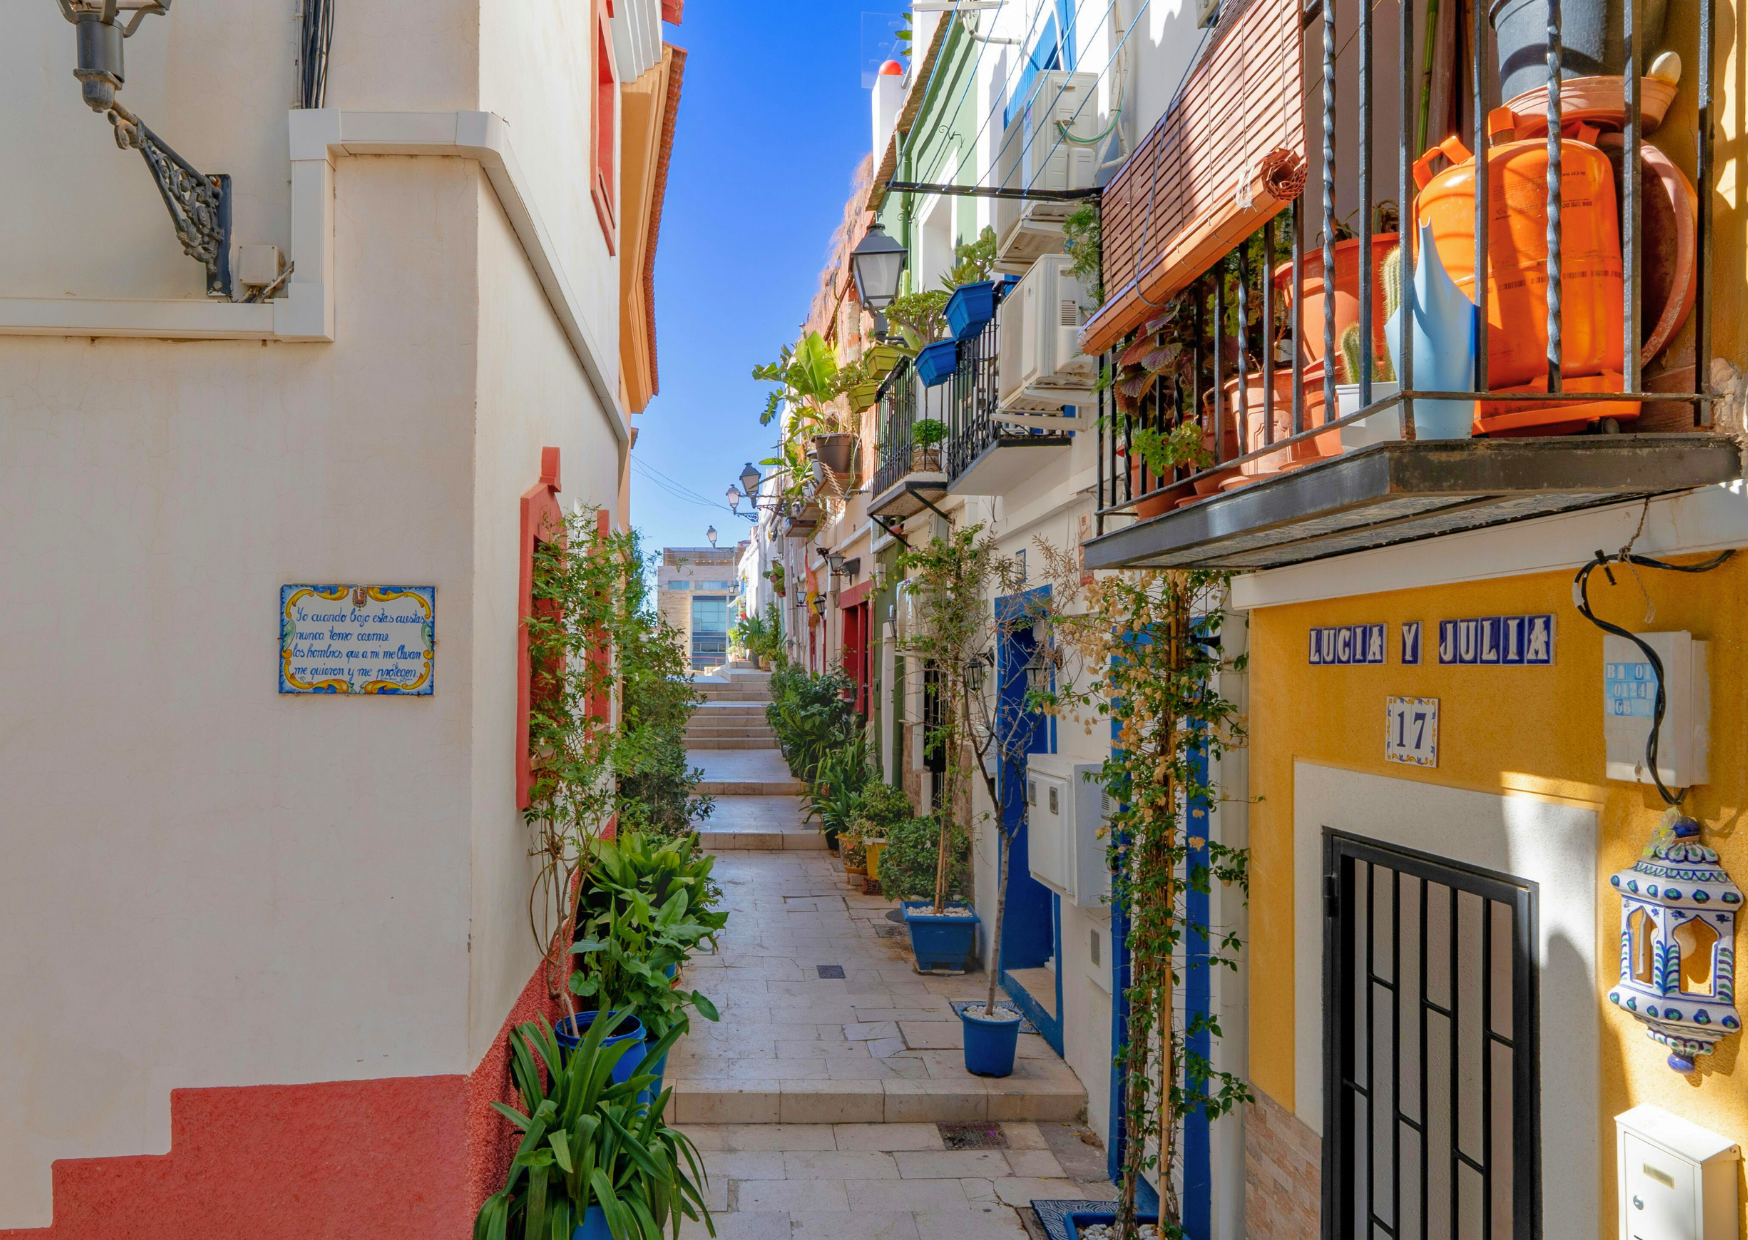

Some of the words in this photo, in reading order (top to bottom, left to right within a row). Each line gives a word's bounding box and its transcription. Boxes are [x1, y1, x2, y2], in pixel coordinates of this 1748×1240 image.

[296, 607, 309, 622] Yo
[311, 607, 347, 622] cuando
[350, 608, 370, 627] bajo
[372, 608, 394, 623] estas
[395, 610, 425, 624] cuestas
[295, 631, 325, 640] nunca
[329, 625, 353, 641] temo
[357, 631, 390, 642] caerme
[1310, 627, 1382, 662] LUCIA
[1402, 623, 1417, 661] Y
[1440, 617, 1548, 661] JULIA
[292, 643, 305, 658] los
[306, 643, 343, 659] hombres
[346, 650, 359, 664] que
[361, 650, 368, 659] a
[382, 650, 397, 660] me
[397, 645, 421, 660] llevan
[294, 666, 308, 676] me
[310, 663, 344, 680] quieren
[348, 668, 356, 682] y
[357, 666, 373, 677] me
[1396, 711, 1427, 749] 17
